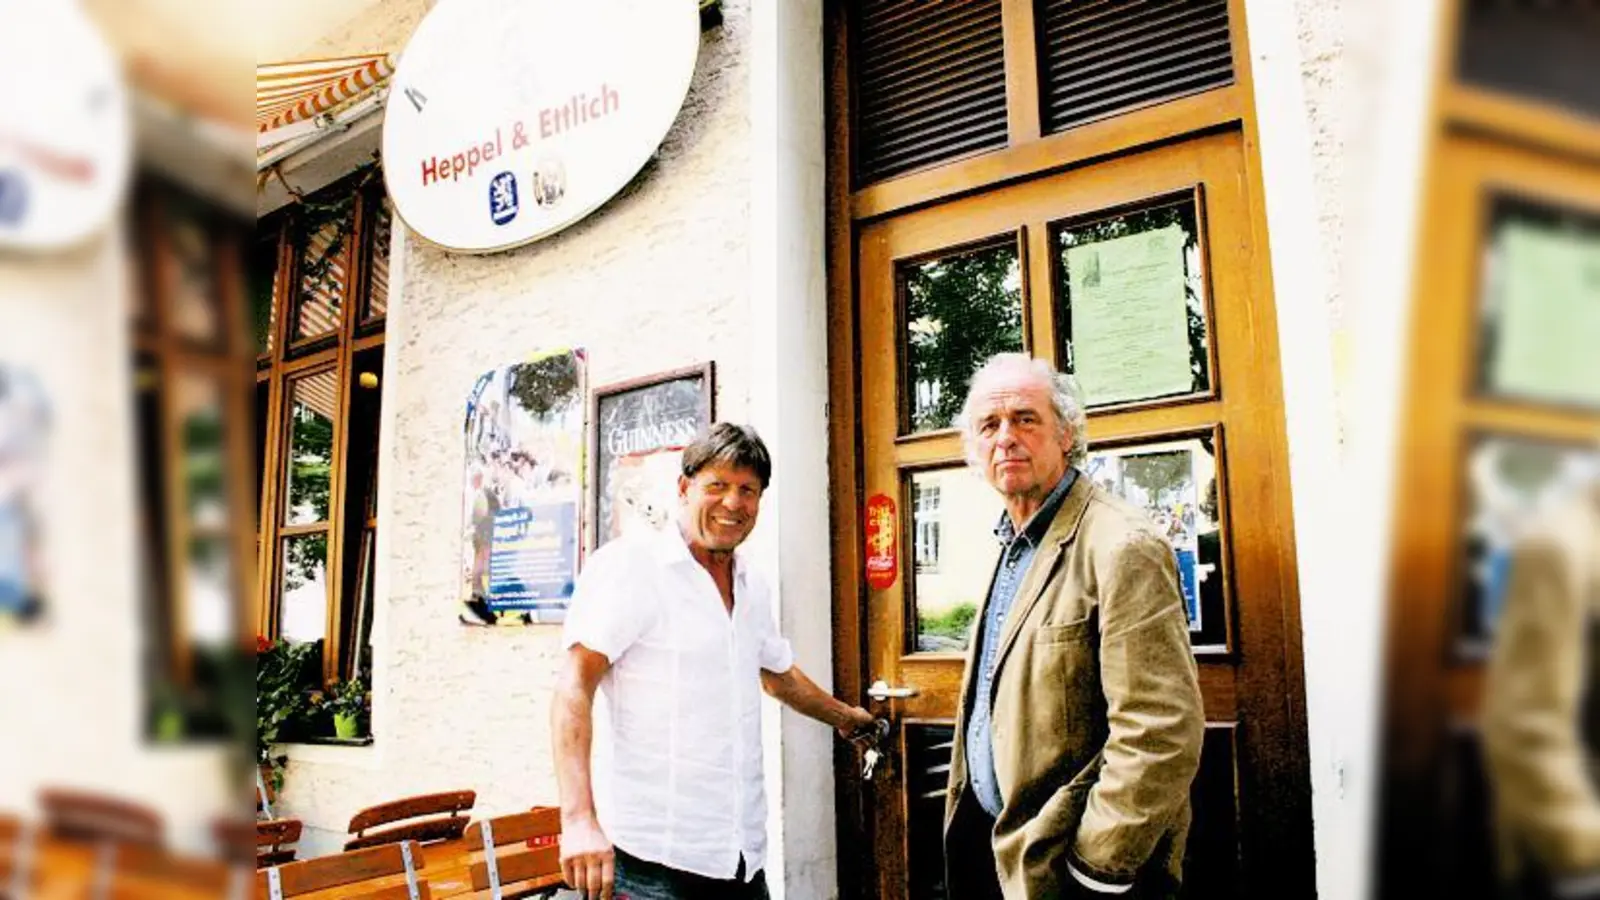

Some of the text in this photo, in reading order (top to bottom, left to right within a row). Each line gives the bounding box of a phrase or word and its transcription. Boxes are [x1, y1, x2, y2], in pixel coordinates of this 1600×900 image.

[421, 82, 619, 186] Heppel & Ettlich
[607, 416, 697, 456] GUINNESS
